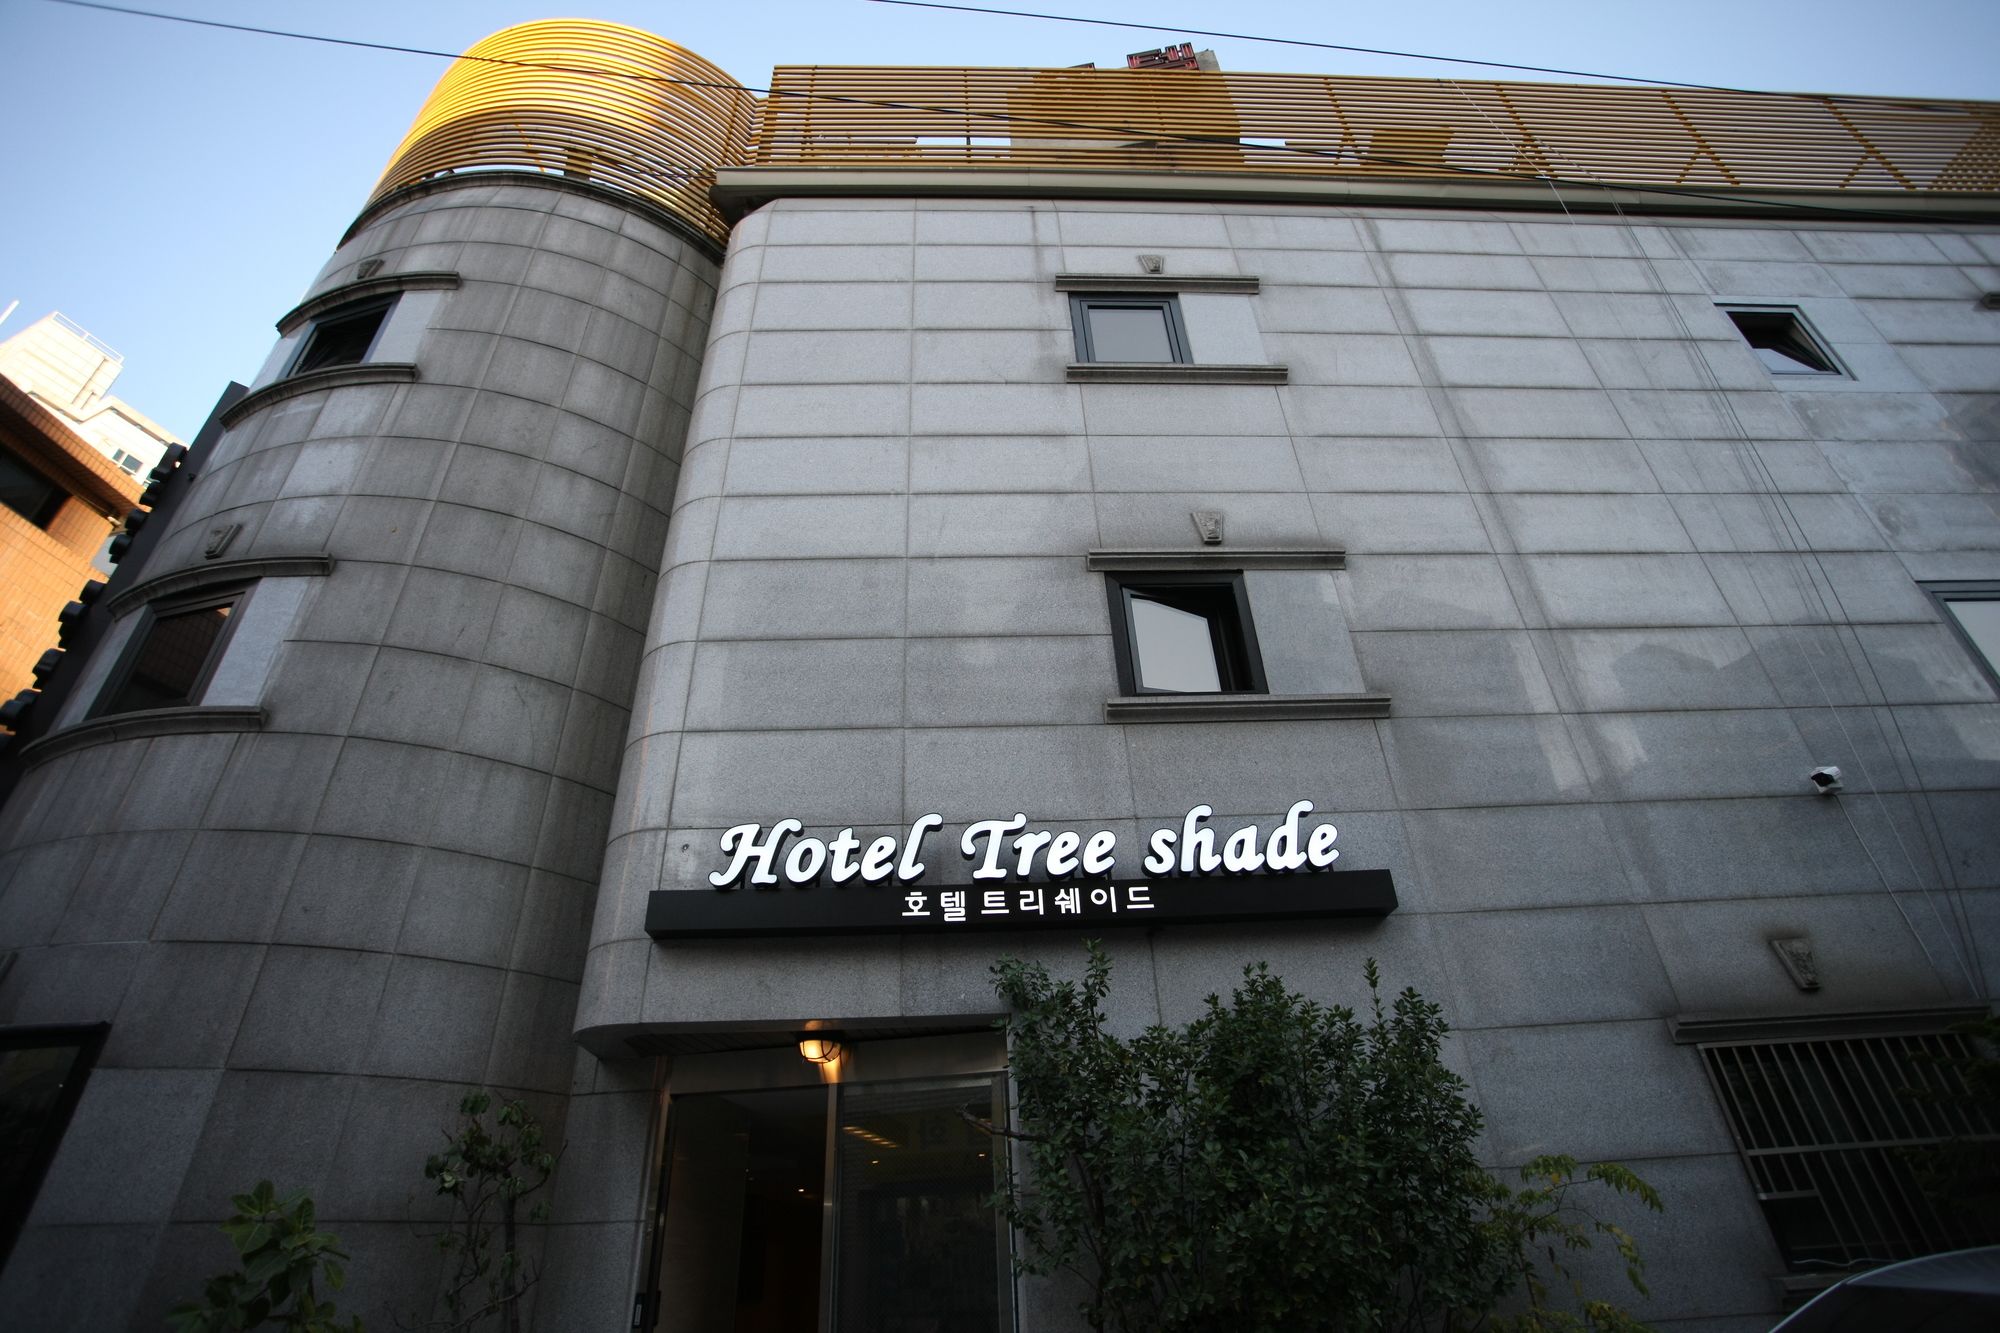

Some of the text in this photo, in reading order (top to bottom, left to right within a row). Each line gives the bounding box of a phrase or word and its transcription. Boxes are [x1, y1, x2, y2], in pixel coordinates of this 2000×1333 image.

[708, 800, 1341, 887] Hotel Tree shade
[901, 890, 967, 922] 호텔
